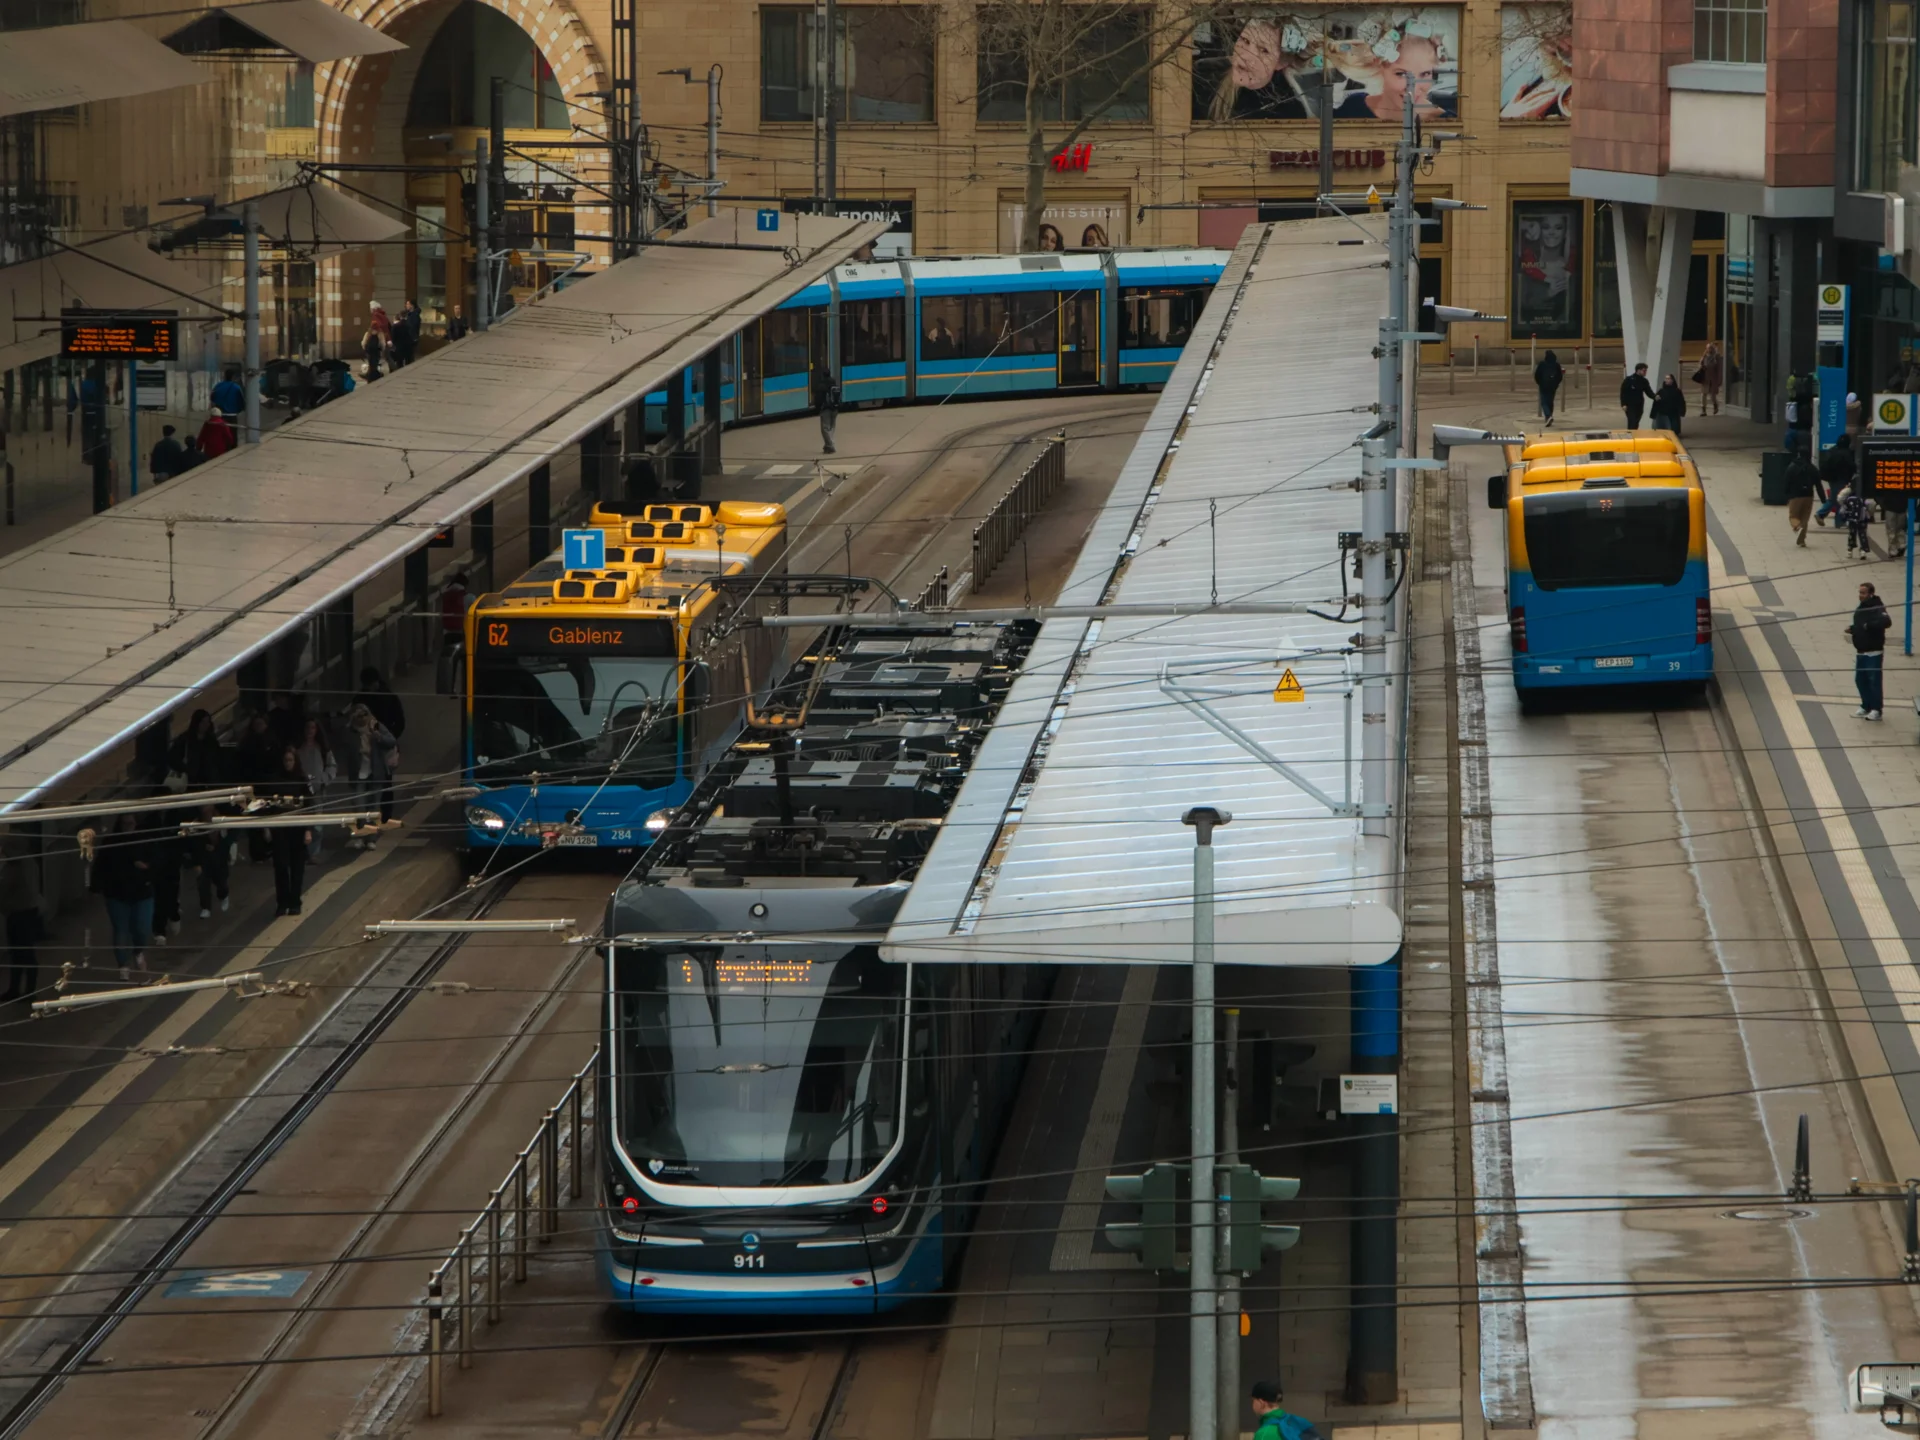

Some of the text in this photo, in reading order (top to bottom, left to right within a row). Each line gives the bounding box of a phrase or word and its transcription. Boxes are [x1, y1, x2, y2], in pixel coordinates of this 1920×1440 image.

[1332, 149, 1385, 168] CLUB
[761, 212, 775, 229] T
[1006, 206, 1121, 219] inmissimi
[1827, 399, 1839, 429] Tickets
[572, 534, 596, 566] T
[488, 622, 624, 647] 62 Gablenz
[1668, 660, 1681, 671] 39
[577, 835, 597, 845] 1284
[610, 829, 633, 841] 284
[734, 1254, 765, 1269] 911
